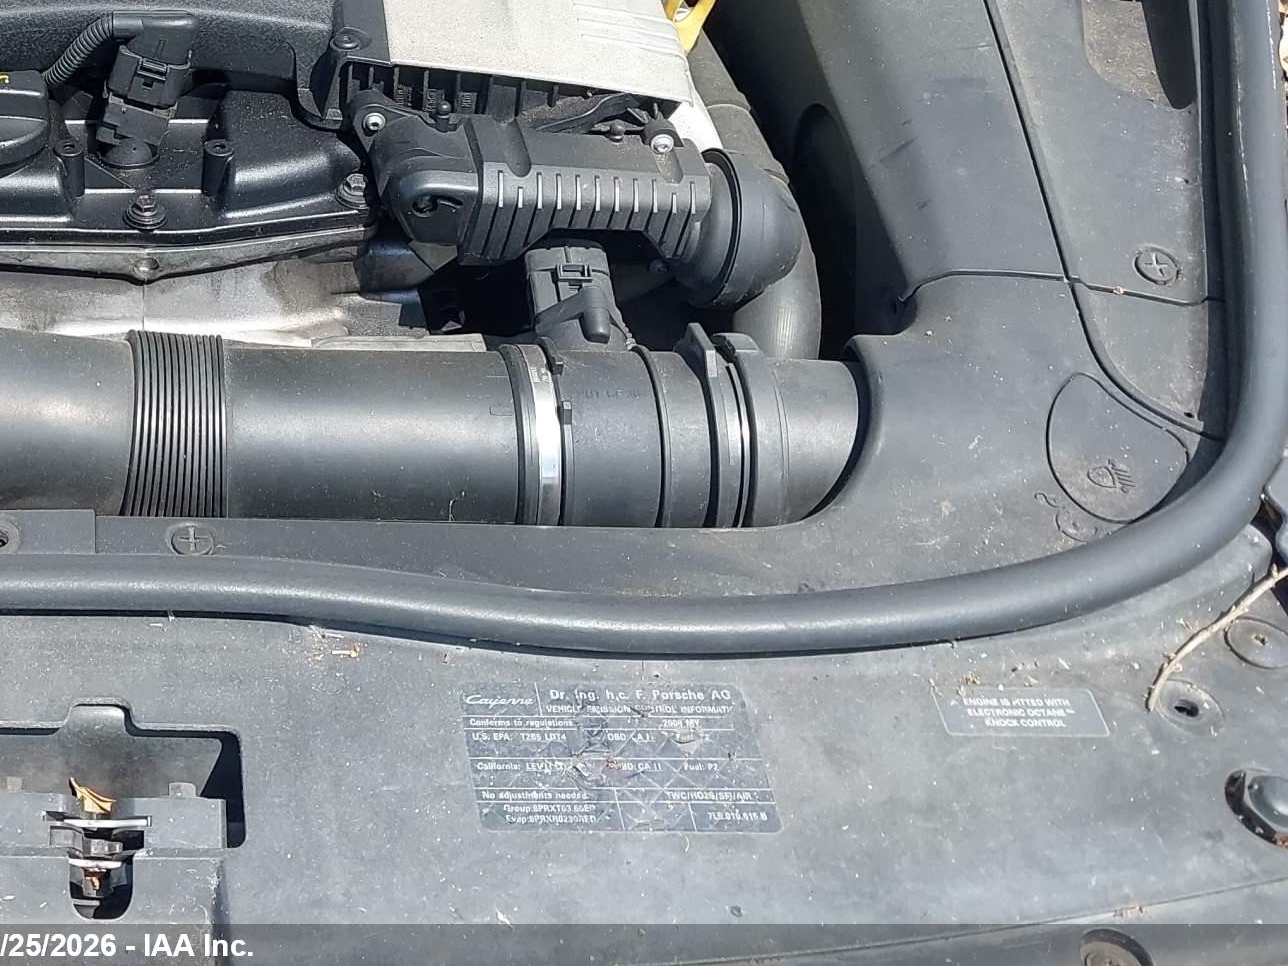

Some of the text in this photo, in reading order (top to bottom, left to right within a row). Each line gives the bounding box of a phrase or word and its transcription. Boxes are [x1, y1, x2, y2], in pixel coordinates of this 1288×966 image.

[549, 689, 569, 700] Dr.
[575, 689, 600, 702] Ing.
[636, 689, 646, 700] F.
[652, 689, 705, 700] Porsche
[711, 689, 731, 700] AG
[464, 694, 535, 709] Cayenne
[962, 698, 998, 706] ENGINE
[999, 698, 1010, 706] IS
[1044, 698, 1071, 706] WITH
[967, 708, 1026, 716] ELECTRONIC
[469, 718, 510, 726] Conforms
[513, 718, 523, 726] to
[984, 718, 1067, 727] KNOCK CONTROL
[472, 733, 490, 741] U.S.
[477, 762, 521, 770] California:
[683, 763, 705, 771] Fuel:
[482, 791, 495, 799] No
[555, 791, 589, 800] needed.
